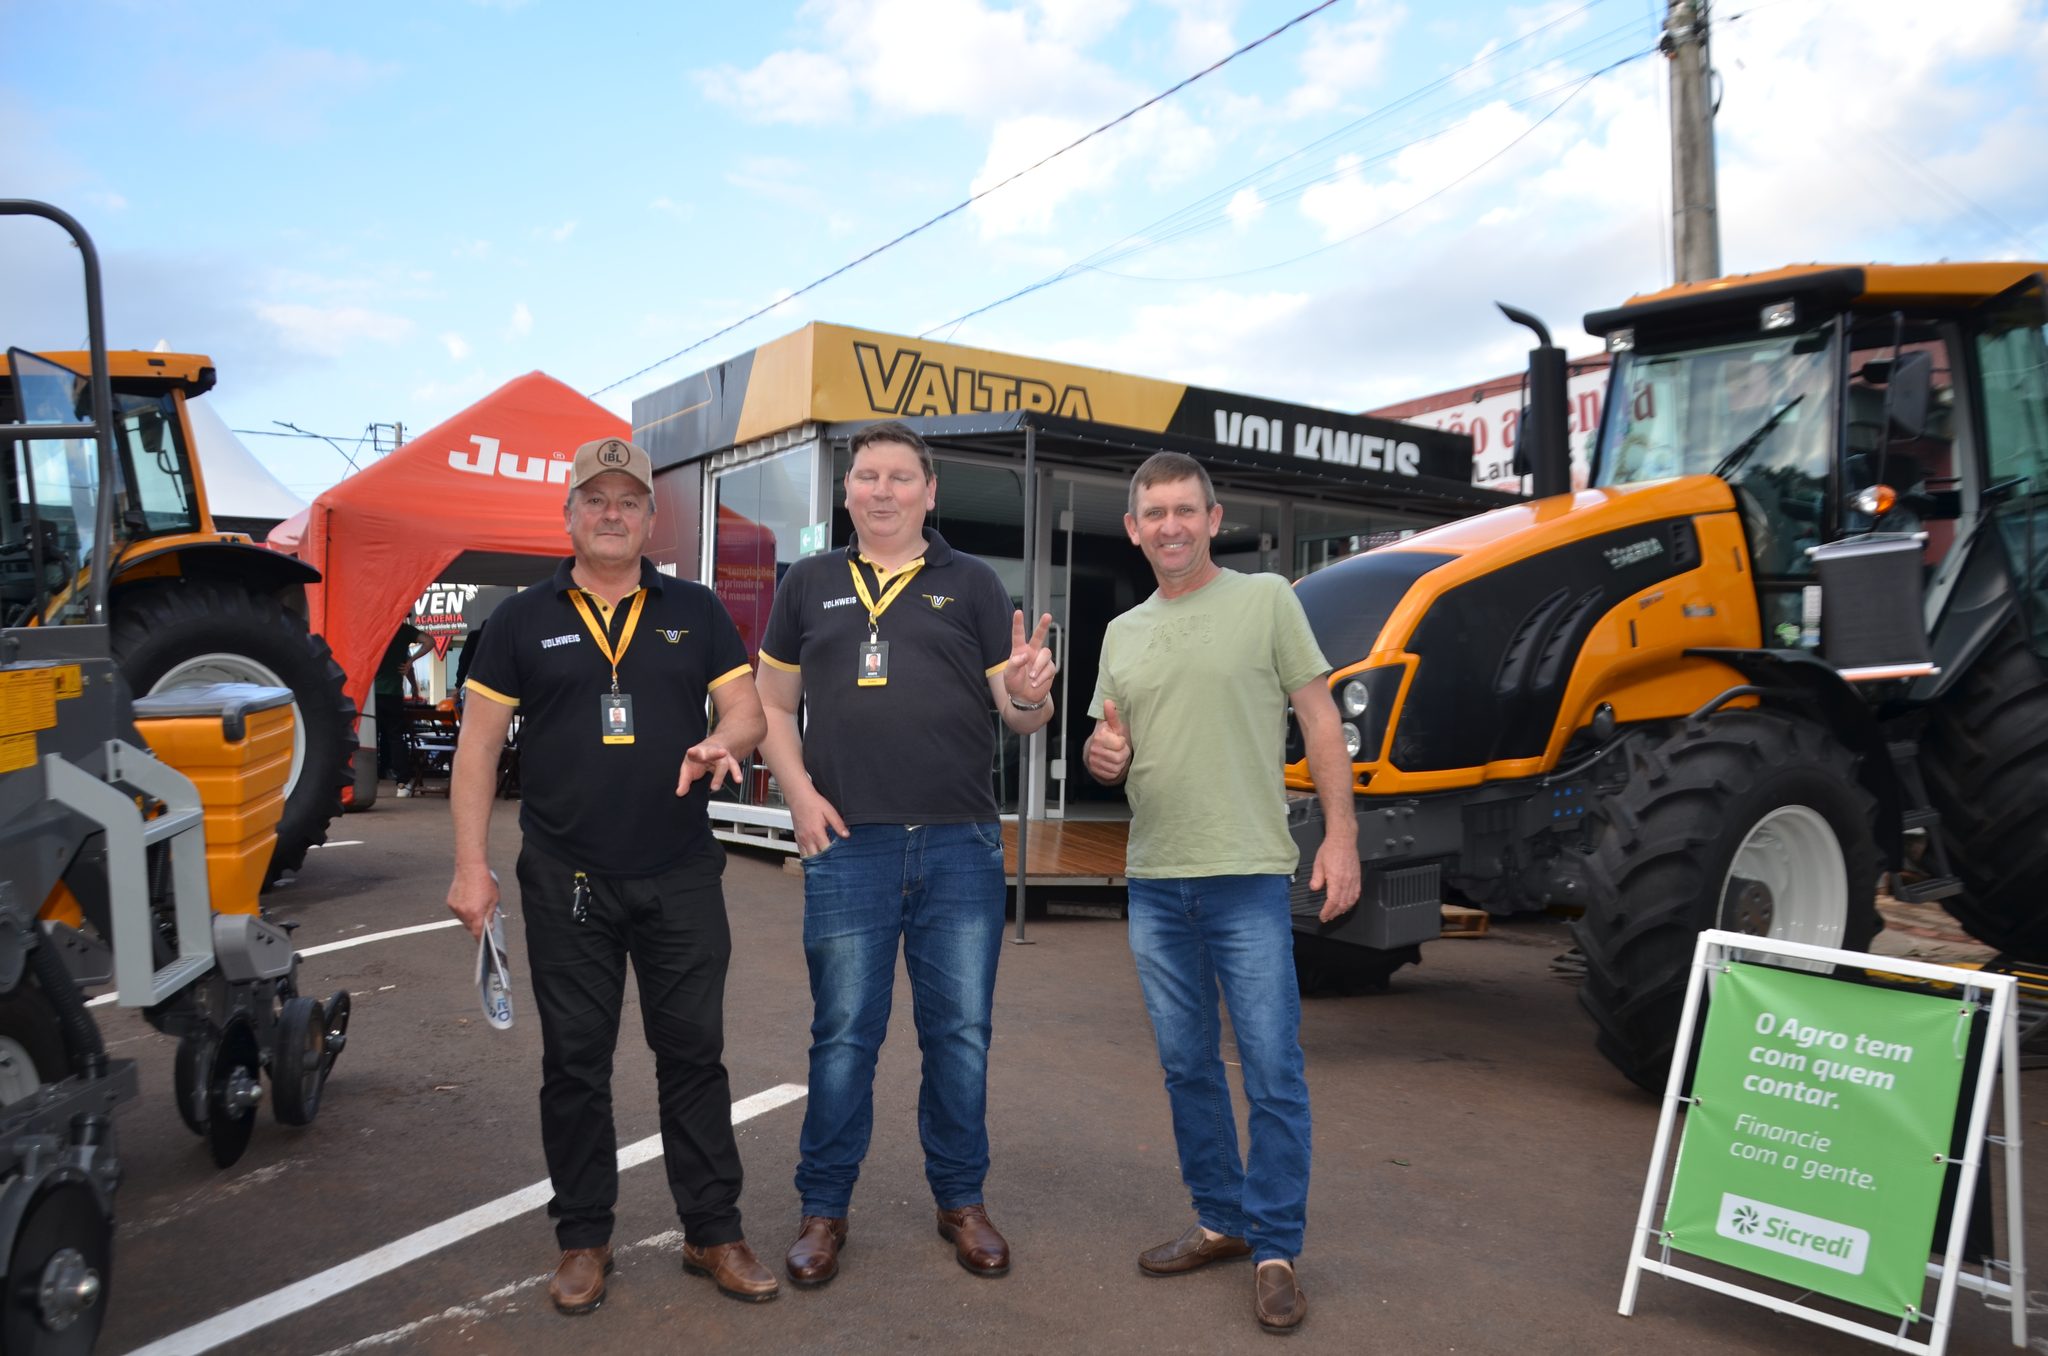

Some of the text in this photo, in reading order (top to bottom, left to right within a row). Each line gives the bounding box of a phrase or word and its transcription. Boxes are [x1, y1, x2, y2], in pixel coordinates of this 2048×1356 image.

[603, 452, 623, 464] IBL
[415, 613, 463, 625] ACADEMIA
[823, 596, 857, 610] VOLKWEIS
[541, 634, 581, 649] VOLKWEIS
[1755, 1012, 1913, 1063] O Agro tem
[1749, 1046, 1895, 1091] com quem
[1743, 1074, 1840, 1110] contar.
[1734, 1113, 1832, 1152] Financie
[1729, 1142, 1877, 1191] com a gente.
[1762, 1217, 1854, 1259] Sicredi
